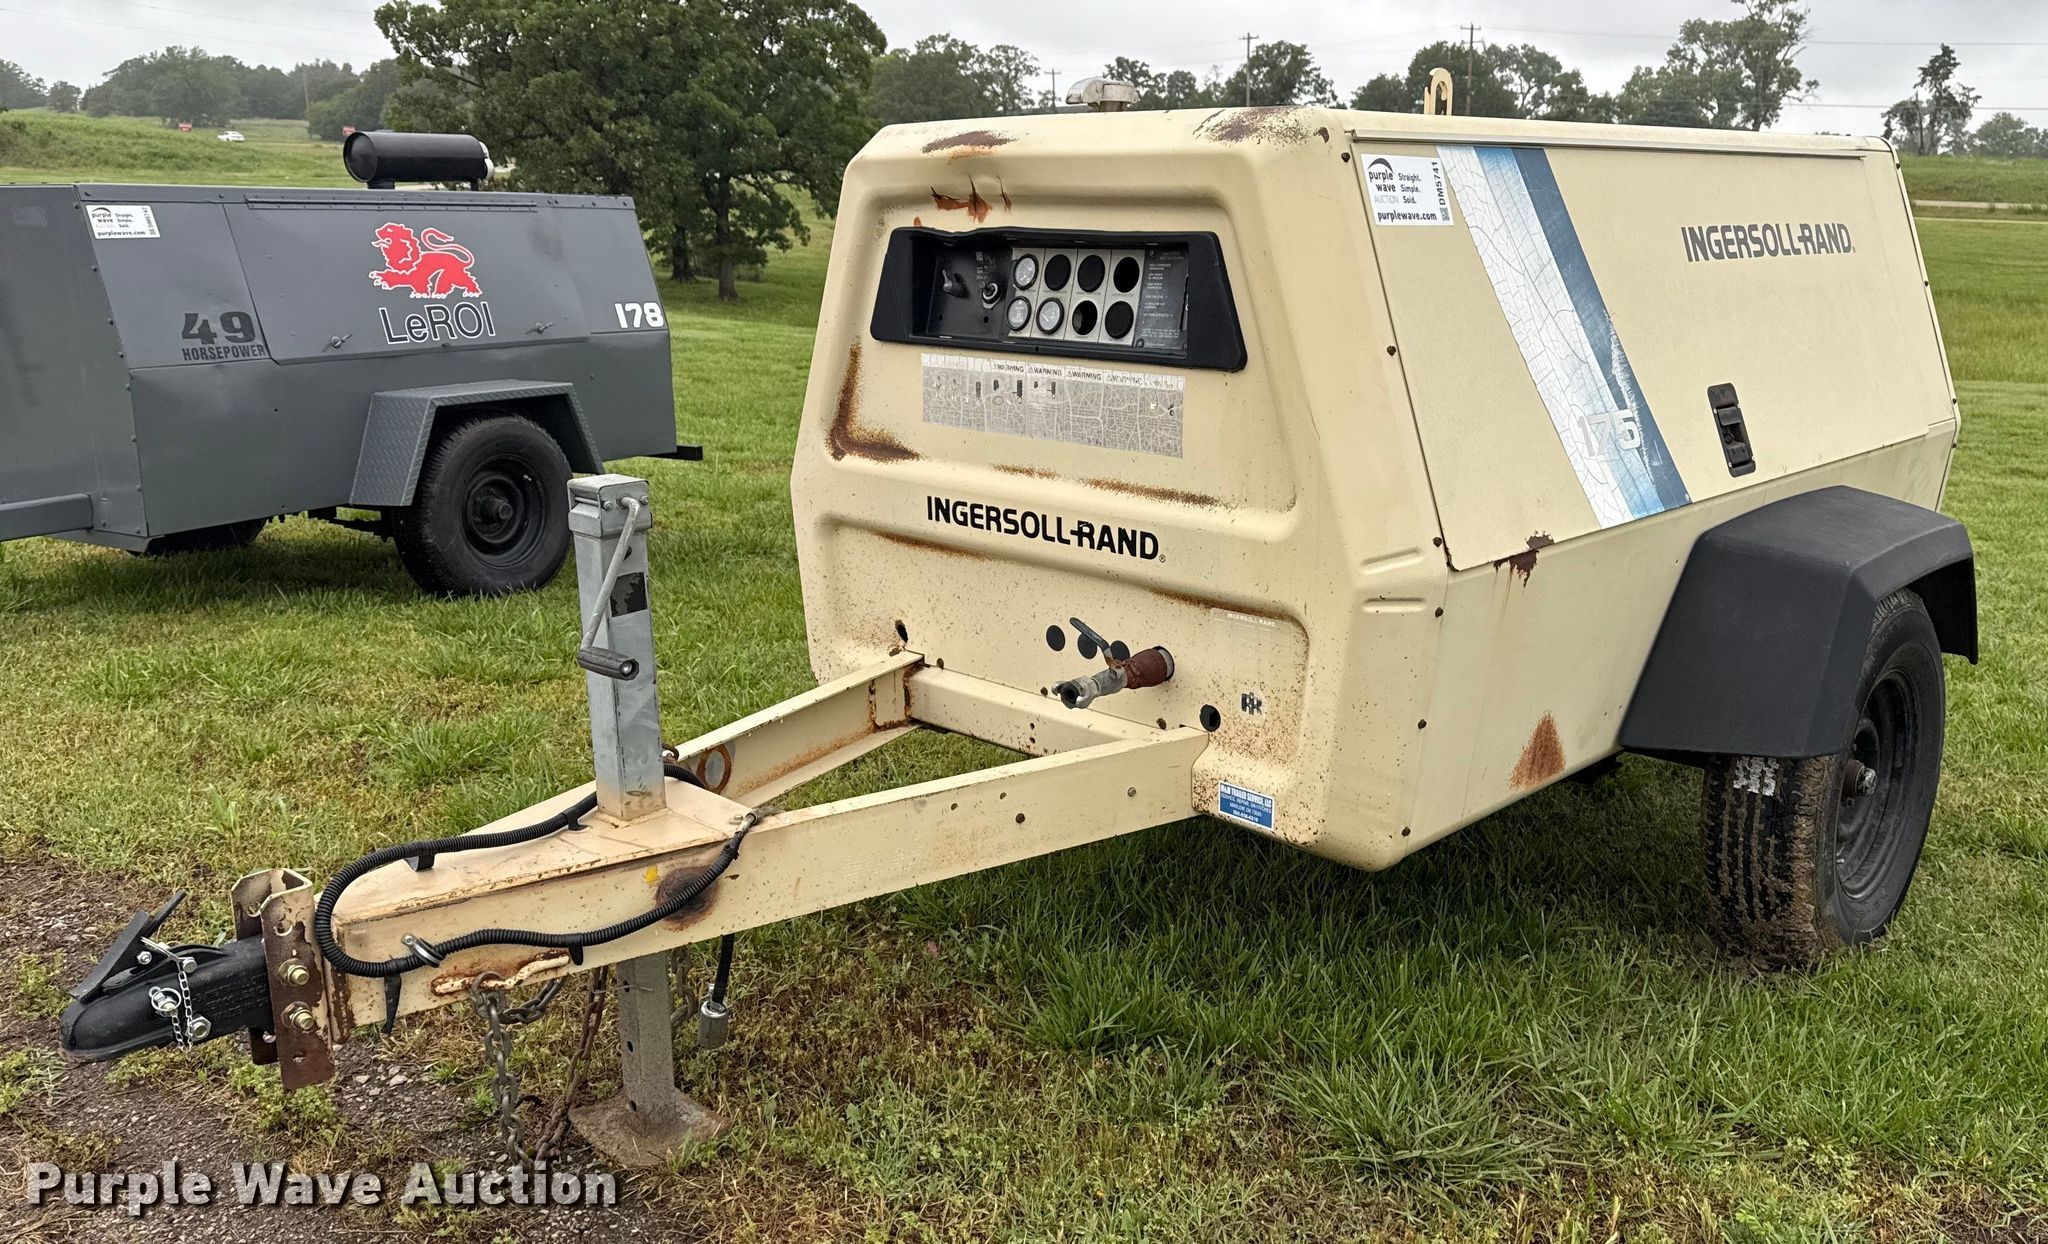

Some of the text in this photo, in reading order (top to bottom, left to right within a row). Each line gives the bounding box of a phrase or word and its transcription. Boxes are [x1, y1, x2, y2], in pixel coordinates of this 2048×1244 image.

[1368, 169, 1394, 182] purple
[1375, 184, 1396, 192] wave
[1398, 173, 1421, 183] Straight.
[1431, 161, 1446, 206] DM5741
[1377, 210, 1437, 222] purplewave.com
[1681, 223, 1852, 262] INGERSOLL-RAND
[181, 311, 256, 345] 49
[379, 301, 496, 344] LeROI
[614, 302, 665, 329] 178
[182, 344, 266, 361] HORSEPOWER
[1578, 409, 1641, 457] 175
[926, 495, 1160, 561] INGERSOLL-RAND
